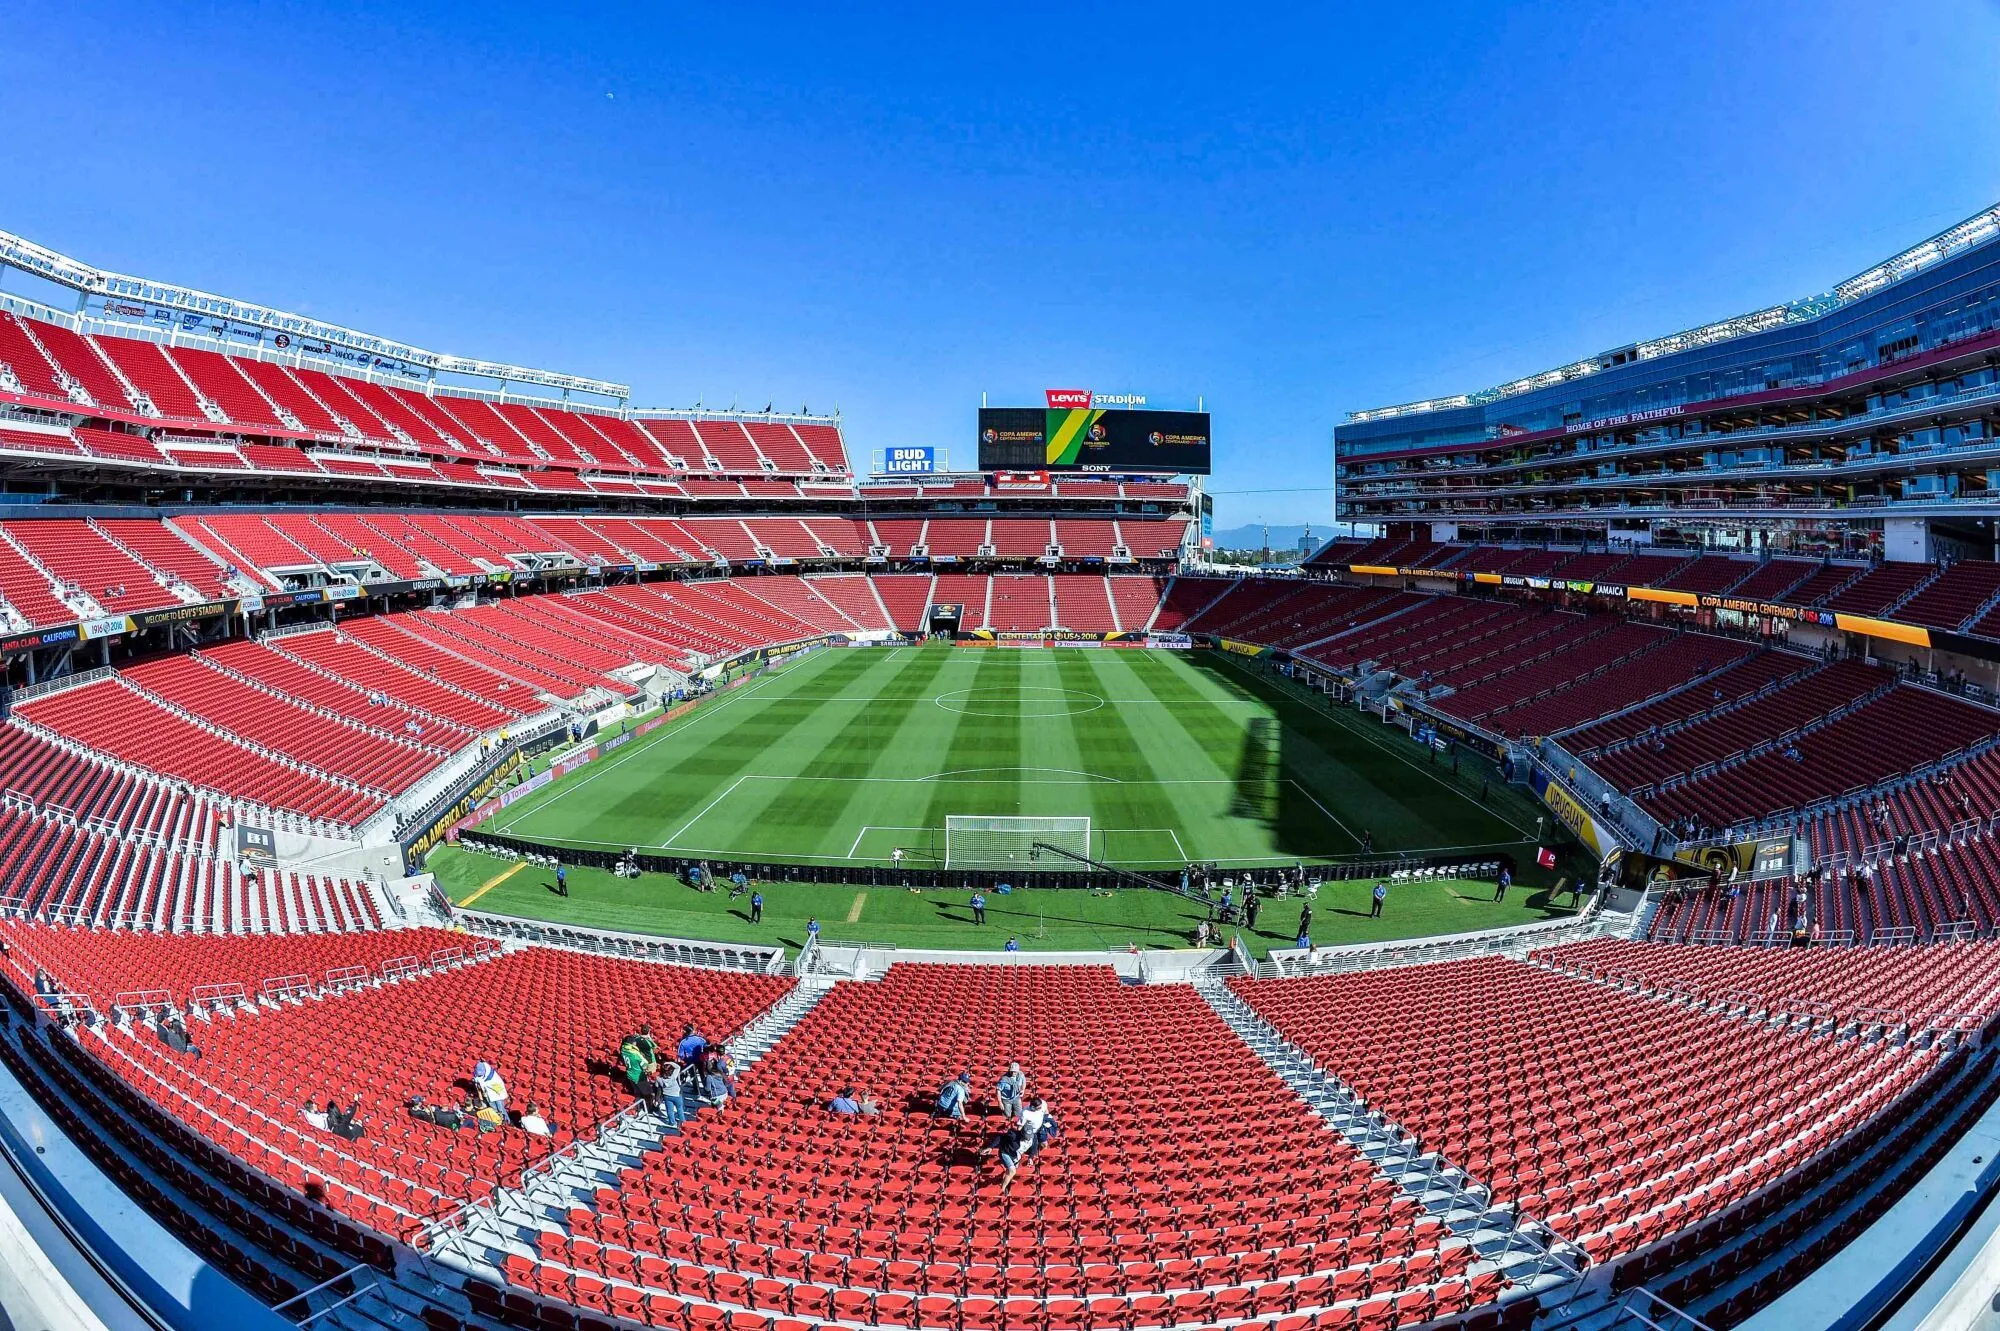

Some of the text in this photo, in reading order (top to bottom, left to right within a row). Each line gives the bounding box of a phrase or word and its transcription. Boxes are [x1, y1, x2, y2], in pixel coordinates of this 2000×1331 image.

[184, 317, 198, 326] SAP
[233, 328, 255, 338] UNITED
[303, 344, 323, 354] BROCADE
[1095, 394, 1146, 404] STADIUM
[1566, 405, 1685, 433] HOME OF THE FAITHFUL
[894, 449, 926, 460] BUD
[888, 460, 931, 471] LIGHT
[474, 575, 486, 584] 0:00
[514, 572, 535, 581] JAMAICA
[1503, 576, 1525, 586] URUGUAY
[413, 580, 440, 590] URUGUAY
[1552, 580, 1565, 589] 0:00
[1595, 585, 1624, 596] JAMAICA
[145, 604, 225, 624] WELCOME TO LEVI'S STADIUM
[1701, 596, 1833, 624] COPA AMERICA CENTENARIO USA 2016
[91, 624, 102, 634] 1916
[110, 622, 122, 631] 2016
[21, 637, 40, 647] CLARA
[42, 630, 77, 643] CALIFORNIA
[1000, 632, 1097, 640] CENTENARIO USA 2016
[767, 648, 781, 656] COPA
[605, 732, 630, 751] SAMSUNG
[510, 785, 530, 799] TOTAL
[1551, 786, 1586, 834] URUGUAY
[408, 834, 430, 864] COPA
[429, 805, 460, 845] AMERICA
[460, 774, 494, 815] CETENARIO
